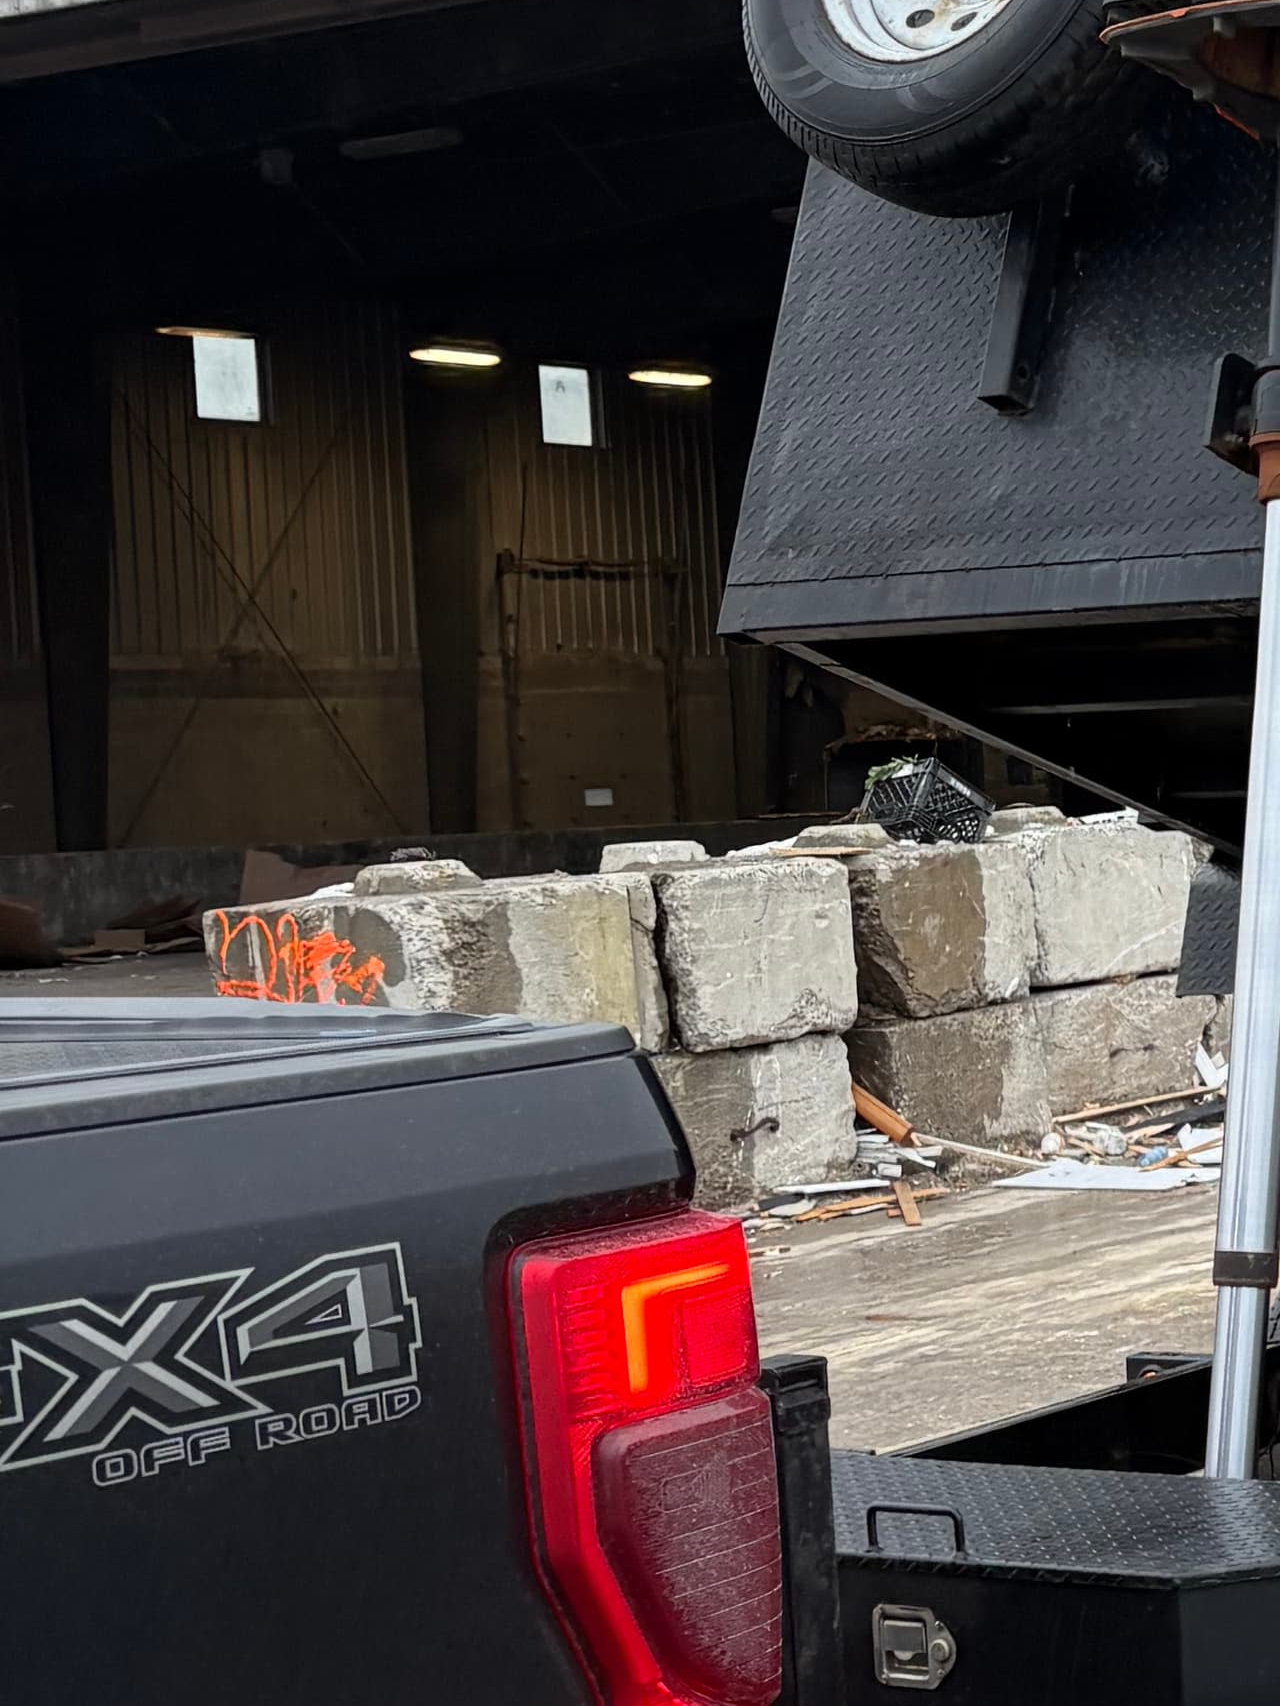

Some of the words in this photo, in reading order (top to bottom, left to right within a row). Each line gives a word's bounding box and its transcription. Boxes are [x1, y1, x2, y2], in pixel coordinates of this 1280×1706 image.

[0, 1241, 423, 1472] X4
[92, 1426, 232, 1487] OFF
[254, 1384, 422, 1451] ROAD
